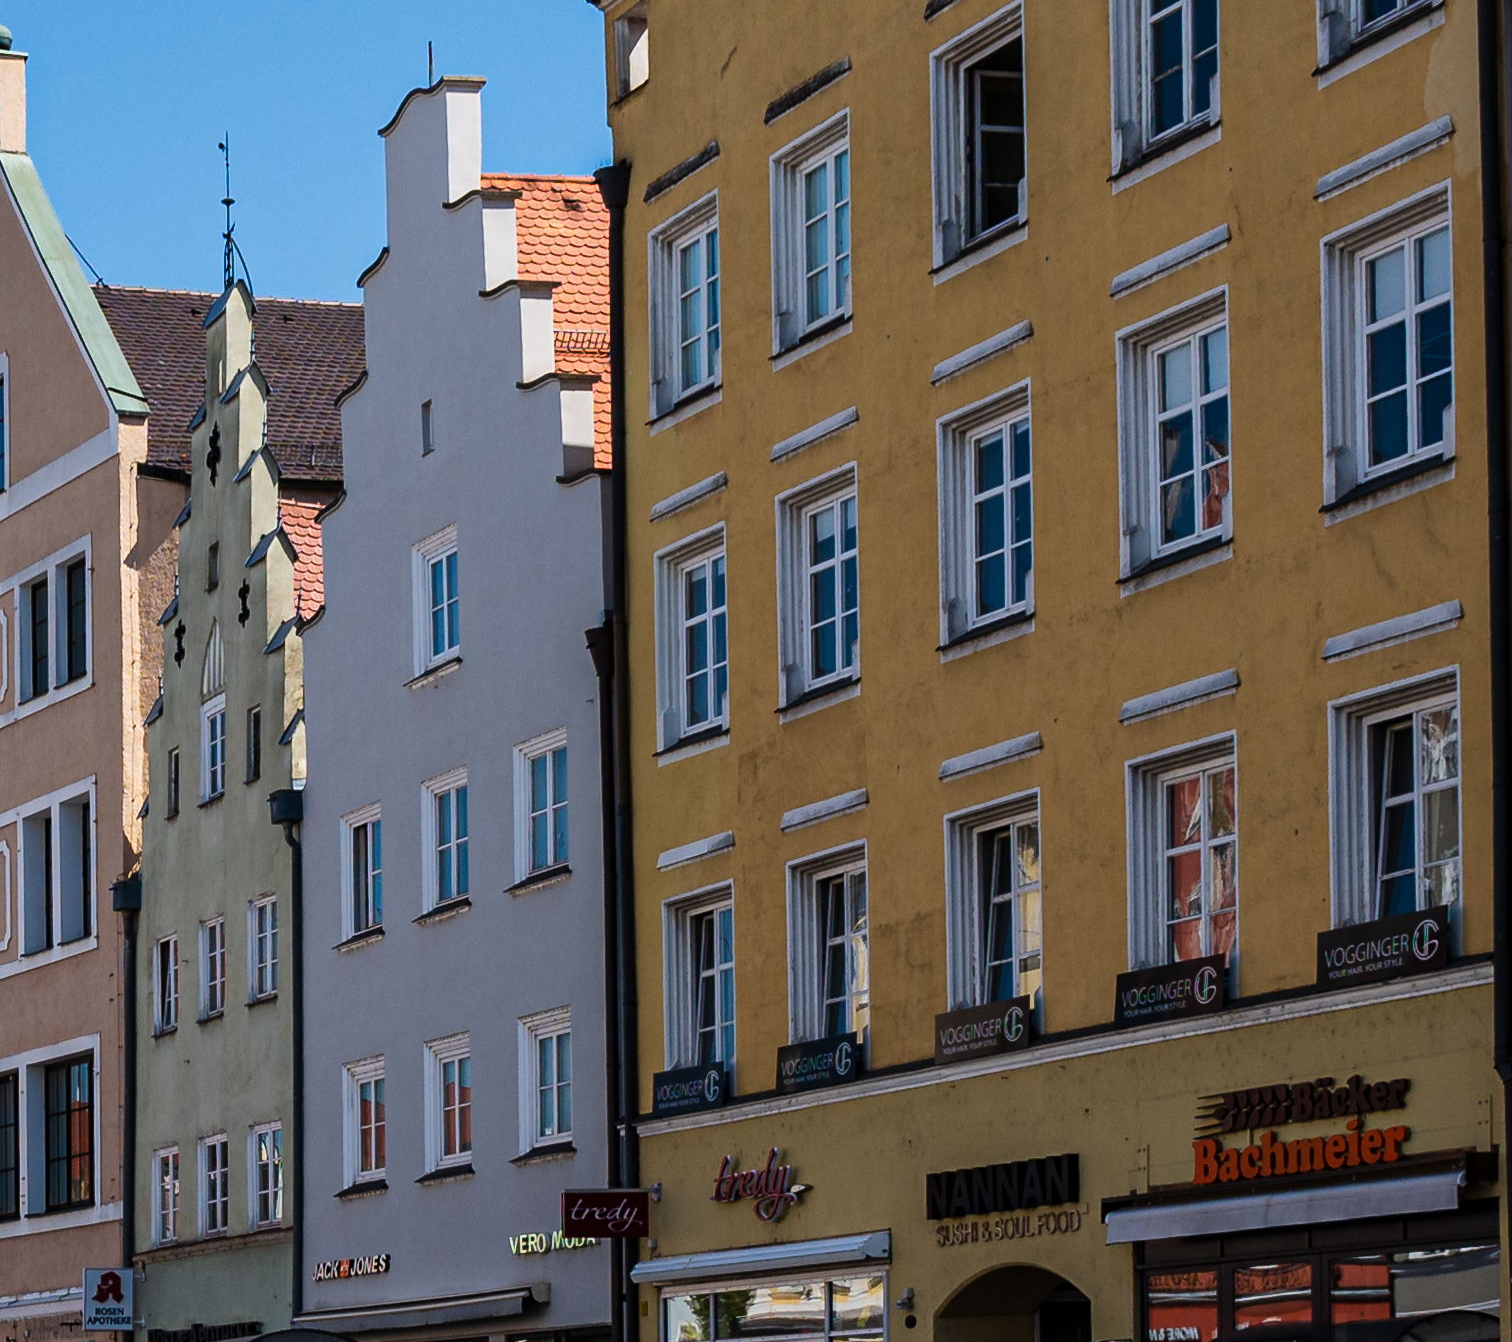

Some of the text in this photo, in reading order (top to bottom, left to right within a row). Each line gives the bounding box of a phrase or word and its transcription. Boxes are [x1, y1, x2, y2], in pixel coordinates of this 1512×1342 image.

[1324, 934, 1409, 968] VOGGINGER
[1365, 962, 1383, 972] YOUR
[1122, 978, 1192, 1007] VOGGINGER
[940, 1018, 1002, 1046] VOGGINGER
[781, 1052, 834, 1076] VOGGINGER
[656, 1080, 703, 1101] VOGGINGER
[1291, 1074, 1410, 1123] Bäcker
[1192, 1118, 1409, 1186] Bachmeier
[713, 1147, 798, 1222] tredy
[927, 1153, 1078, 1220] NANNAN
[571, 1198, 643, 1232] tredy
[935, 1209, 1081, 1247] SUSHI & SOUL FOOD
[508, 1232, 546, 1256] VERO
[312, 1260, 339, 1281] JACK
[350, 1254, 387, 1276] JONES
[87, 1316, 132, 1325] APOTHEKE
[94, 1307, 124, 1316] ROSEN
